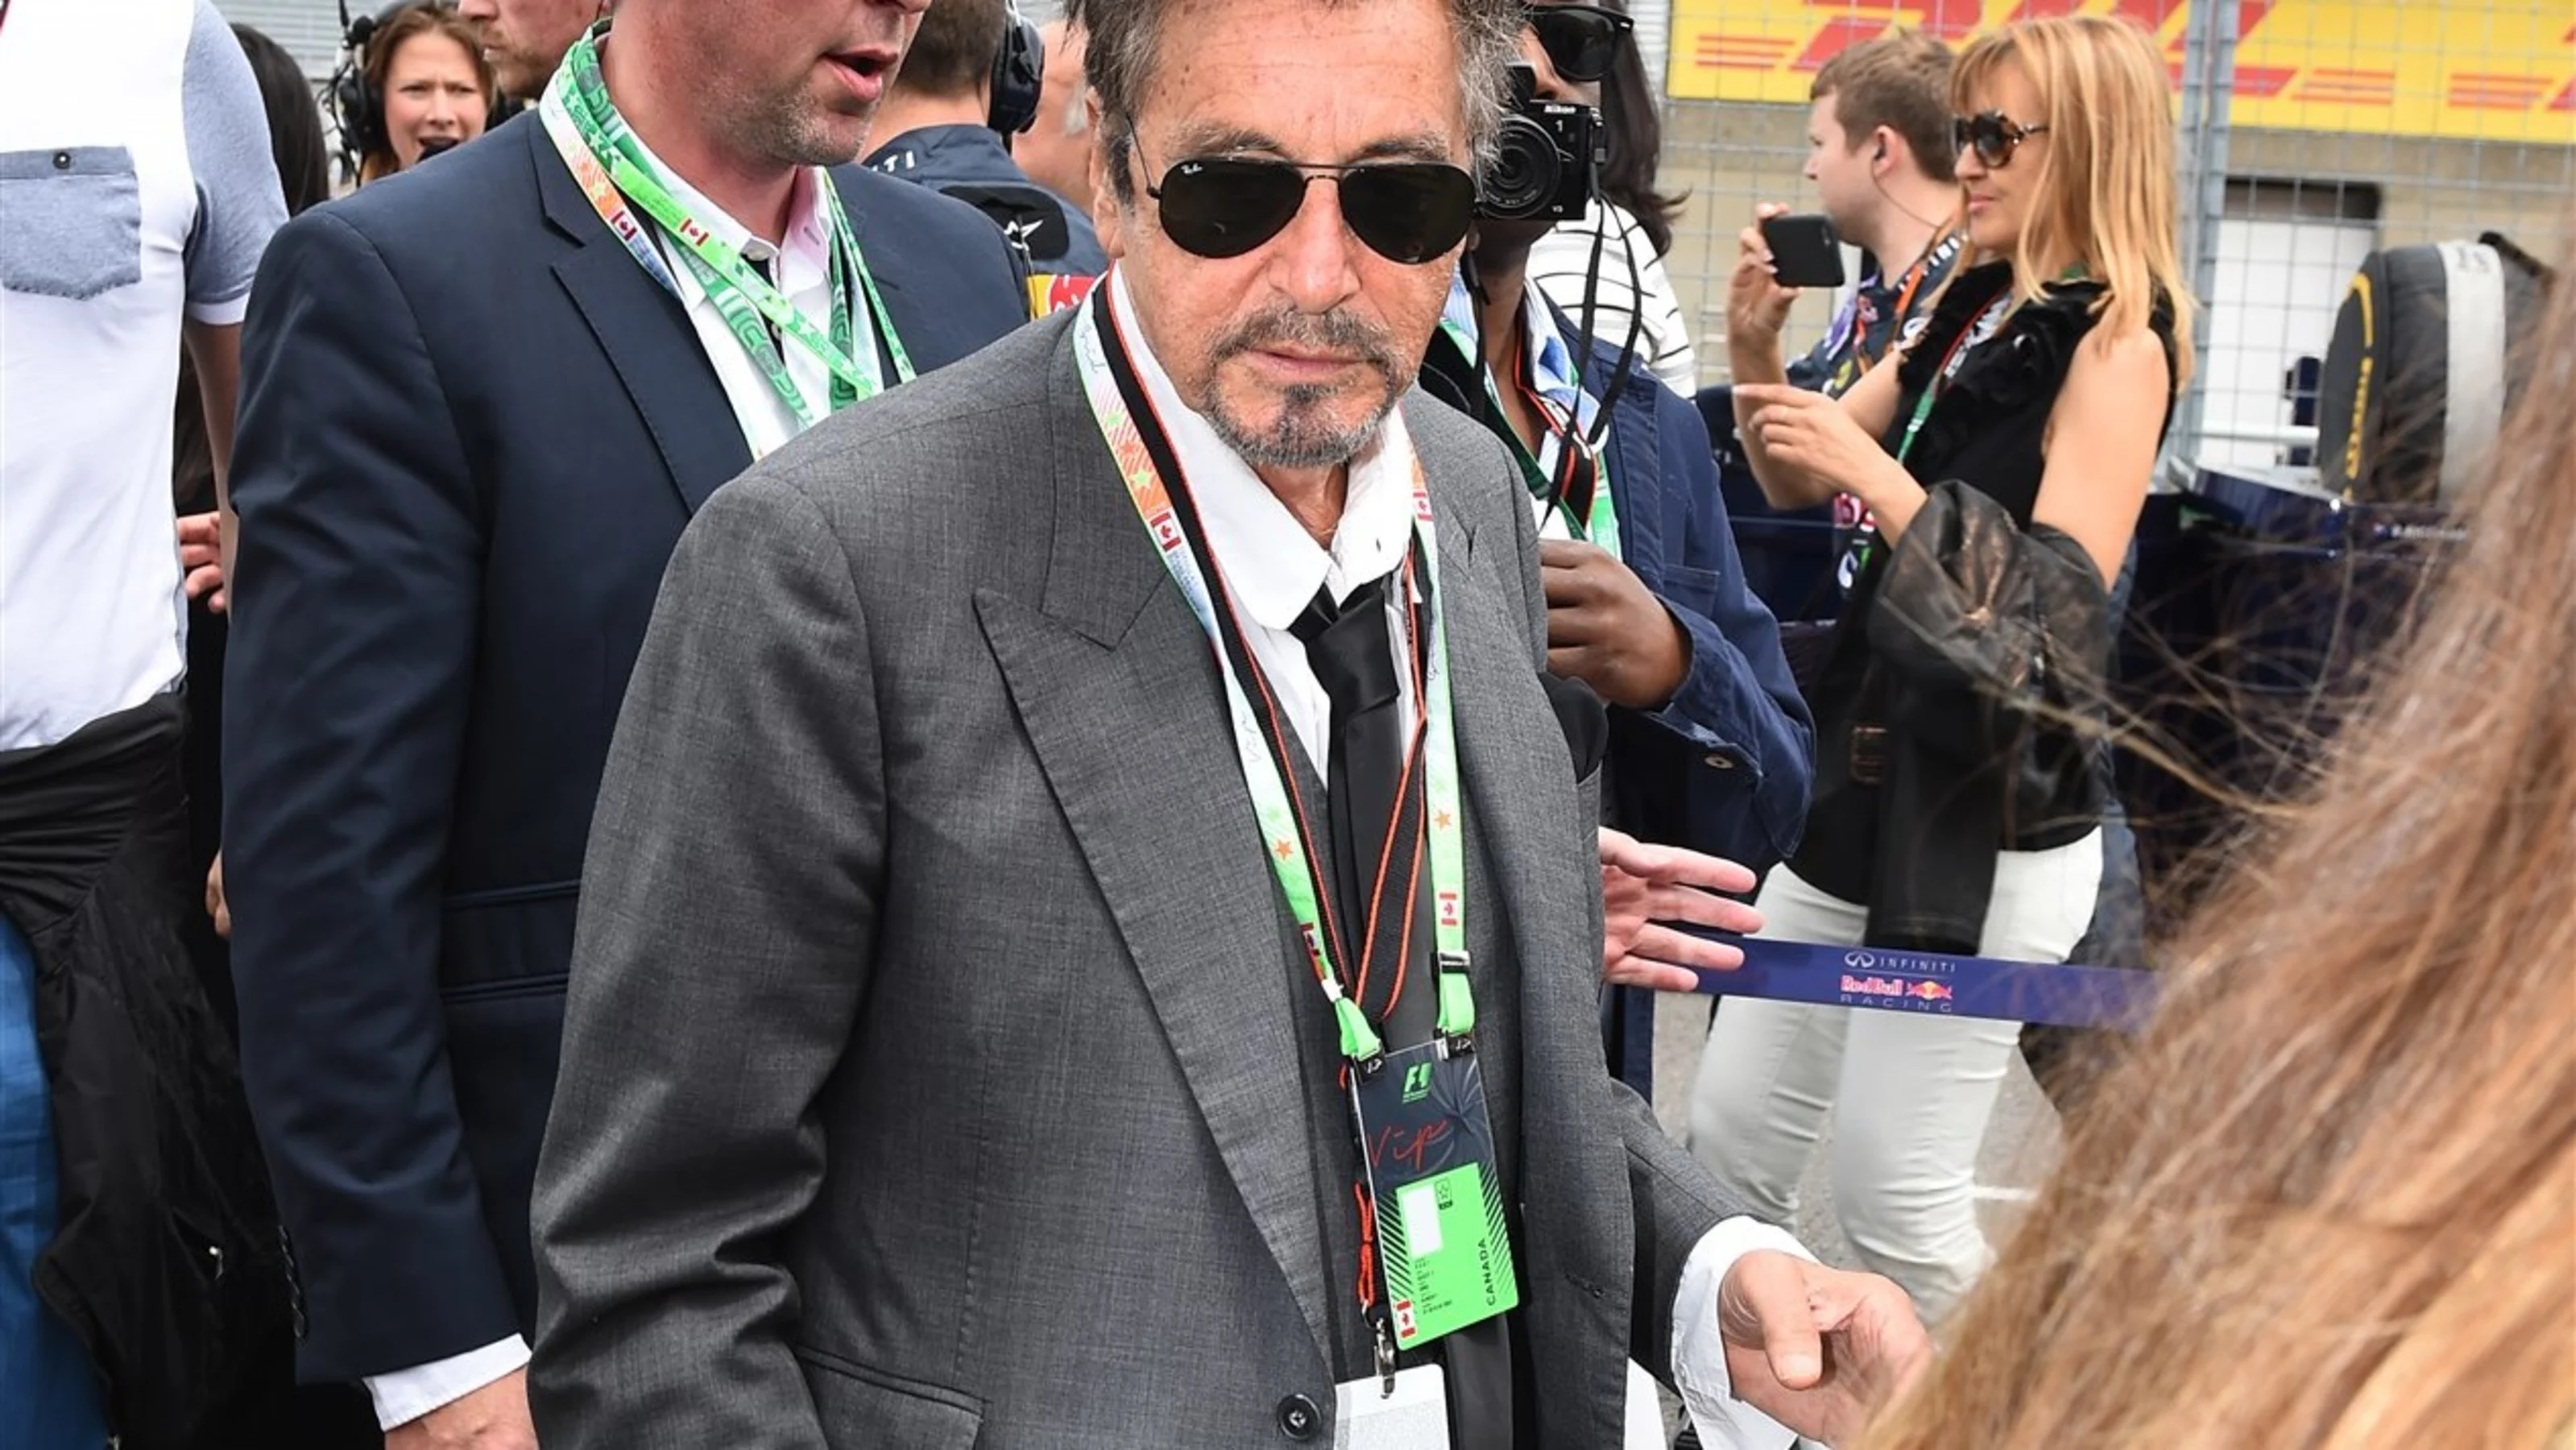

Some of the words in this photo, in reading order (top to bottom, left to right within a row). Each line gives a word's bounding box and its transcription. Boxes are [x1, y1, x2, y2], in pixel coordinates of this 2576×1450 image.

[1879, 956, 1956, 972] INFINITI
[1840, 993, 1952, 1013] RACING
[1477, 1237, 1497, 1307] CANADA
